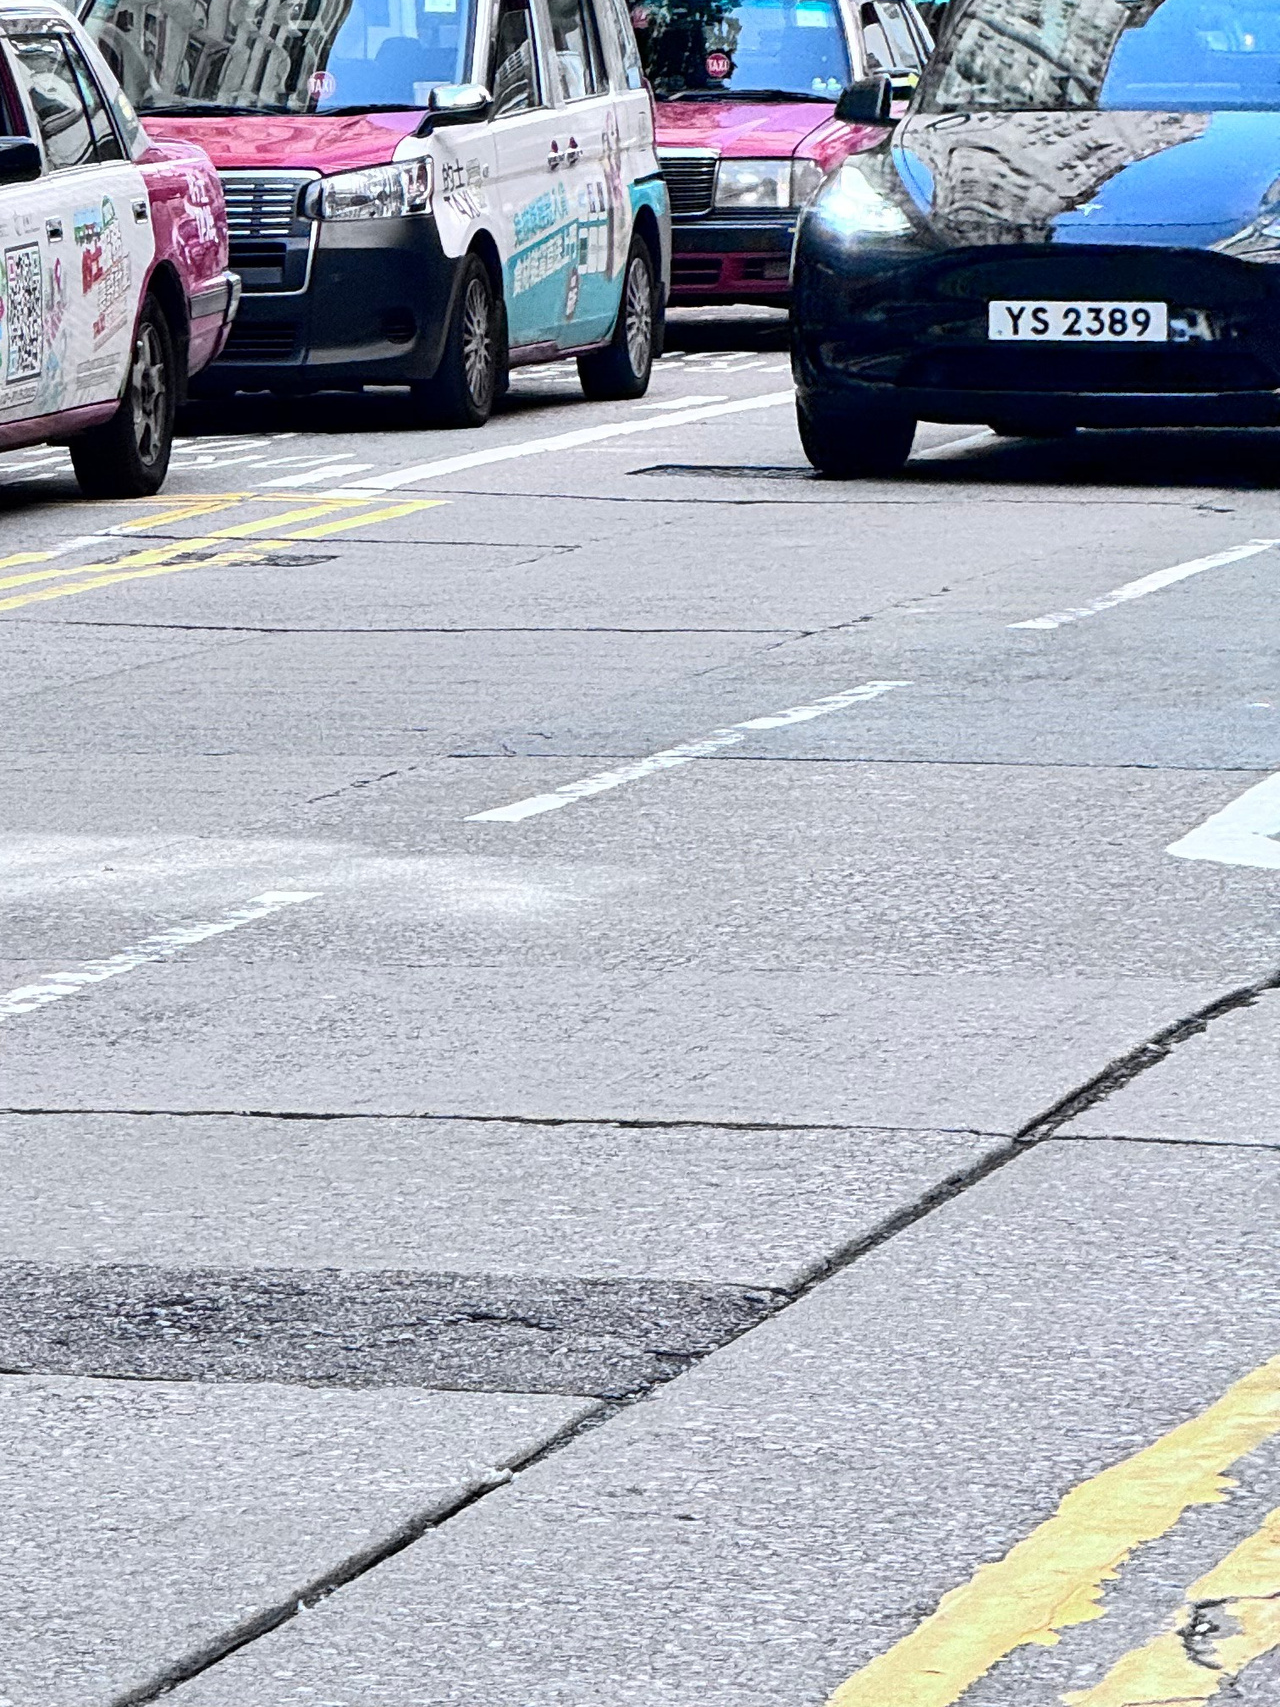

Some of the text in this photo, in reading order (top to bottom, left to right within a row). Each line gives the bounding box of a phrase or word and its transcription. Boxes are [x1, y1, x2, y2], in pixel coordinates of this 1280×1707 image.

[706, 58, 730, 70] TAXI
[308, 77, 334, 93] TAXI
[442, 158, 466, 193] 的士
[443, 188, 481, 221] TAXI
[1005, 306, 1151, 337] YS 2389
